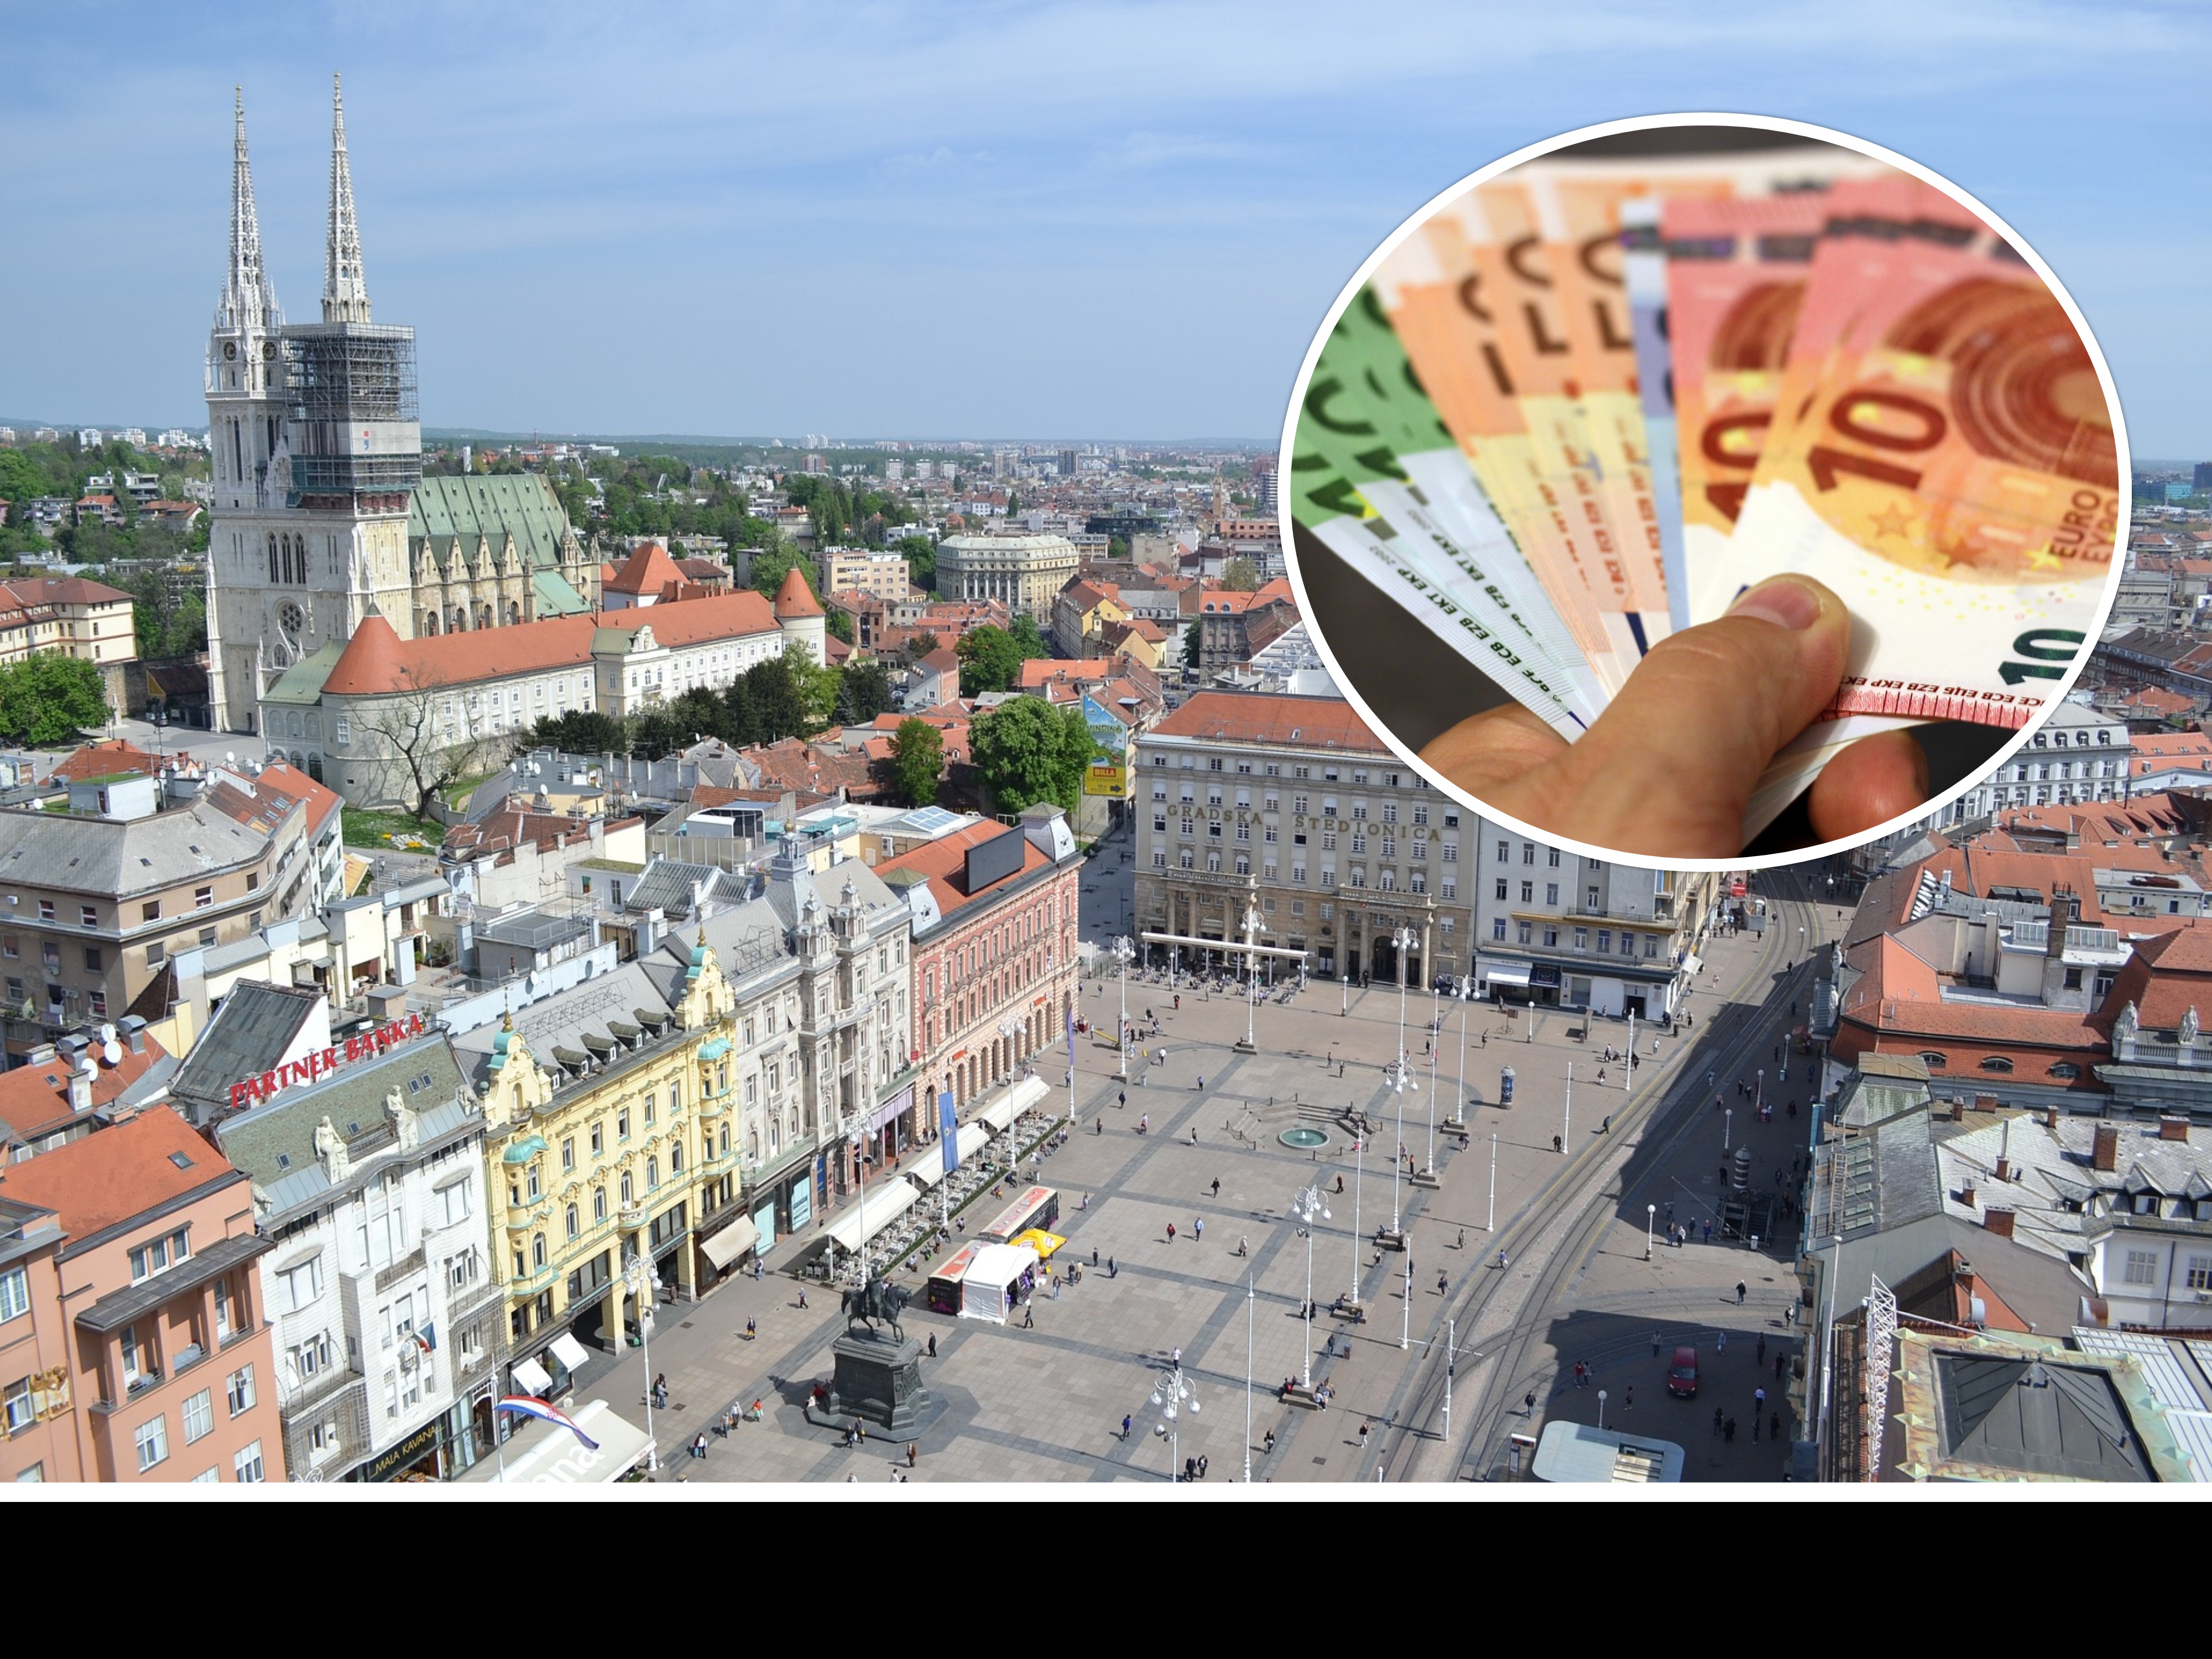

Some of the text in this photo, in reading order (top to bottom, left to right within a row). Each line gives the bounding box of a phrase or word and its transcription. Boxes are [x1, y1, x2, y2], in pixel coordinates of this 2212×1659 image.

[1807, 390, 1948, 493] 10
[2048, 489, 2100, 558] EURO
[1397, 568, 1427, 591] EKP
[1456, 560, 1485, 581] EKT
[1427, 592, 1458, 615] EKT
[1459, 617, 1490, 640] EZB
[1490, 641, 1521, 666] ECB
[1998, 628, 2087, 685] 10
[1871, 679, 1904, 690] EKP
[1907, 682, 1940, 693] EZB
[1981, 691, 2015, 703] ECB
[1167, 805, 1262, 825] GRADSKA
[230, 1014, 422, 1109] PARTNER BANKA
[375, 1425, 437, 1475] MALA KAVANA
